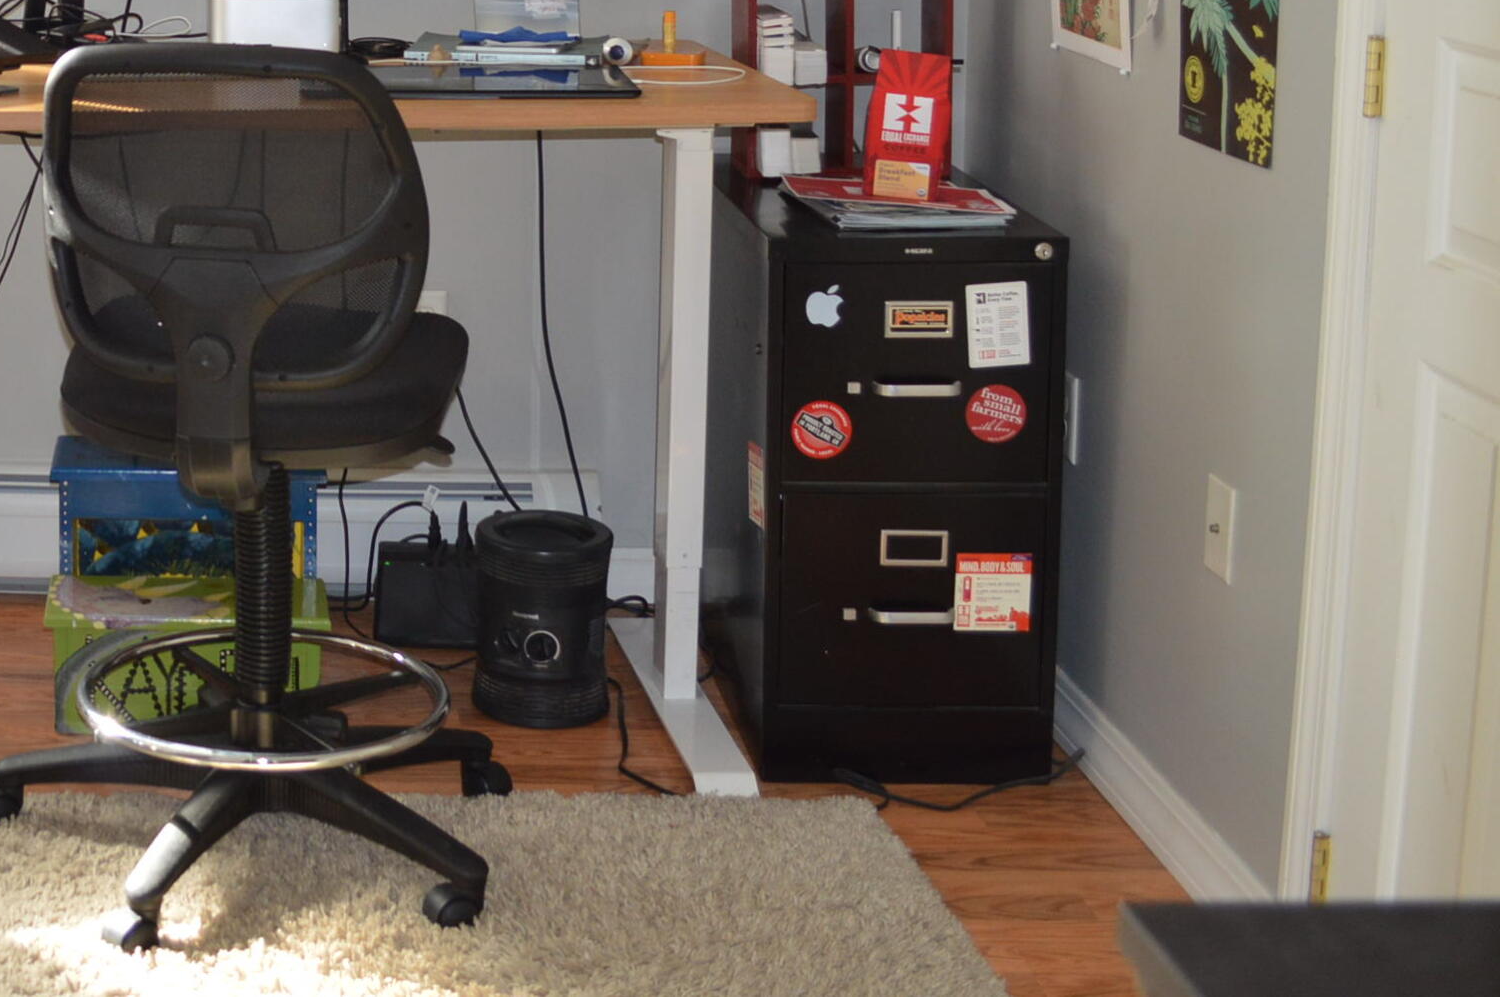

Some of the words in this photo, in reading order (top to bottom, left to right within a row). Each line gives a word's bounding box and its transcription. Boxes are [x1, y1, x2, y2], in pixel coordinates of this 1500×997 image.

[981, 387, 1013, 404] from
[971, 401, 1024, 424] farmers
[983, 399, 1022, 415] small
[1006, 561, 1024, 572] SOUL
